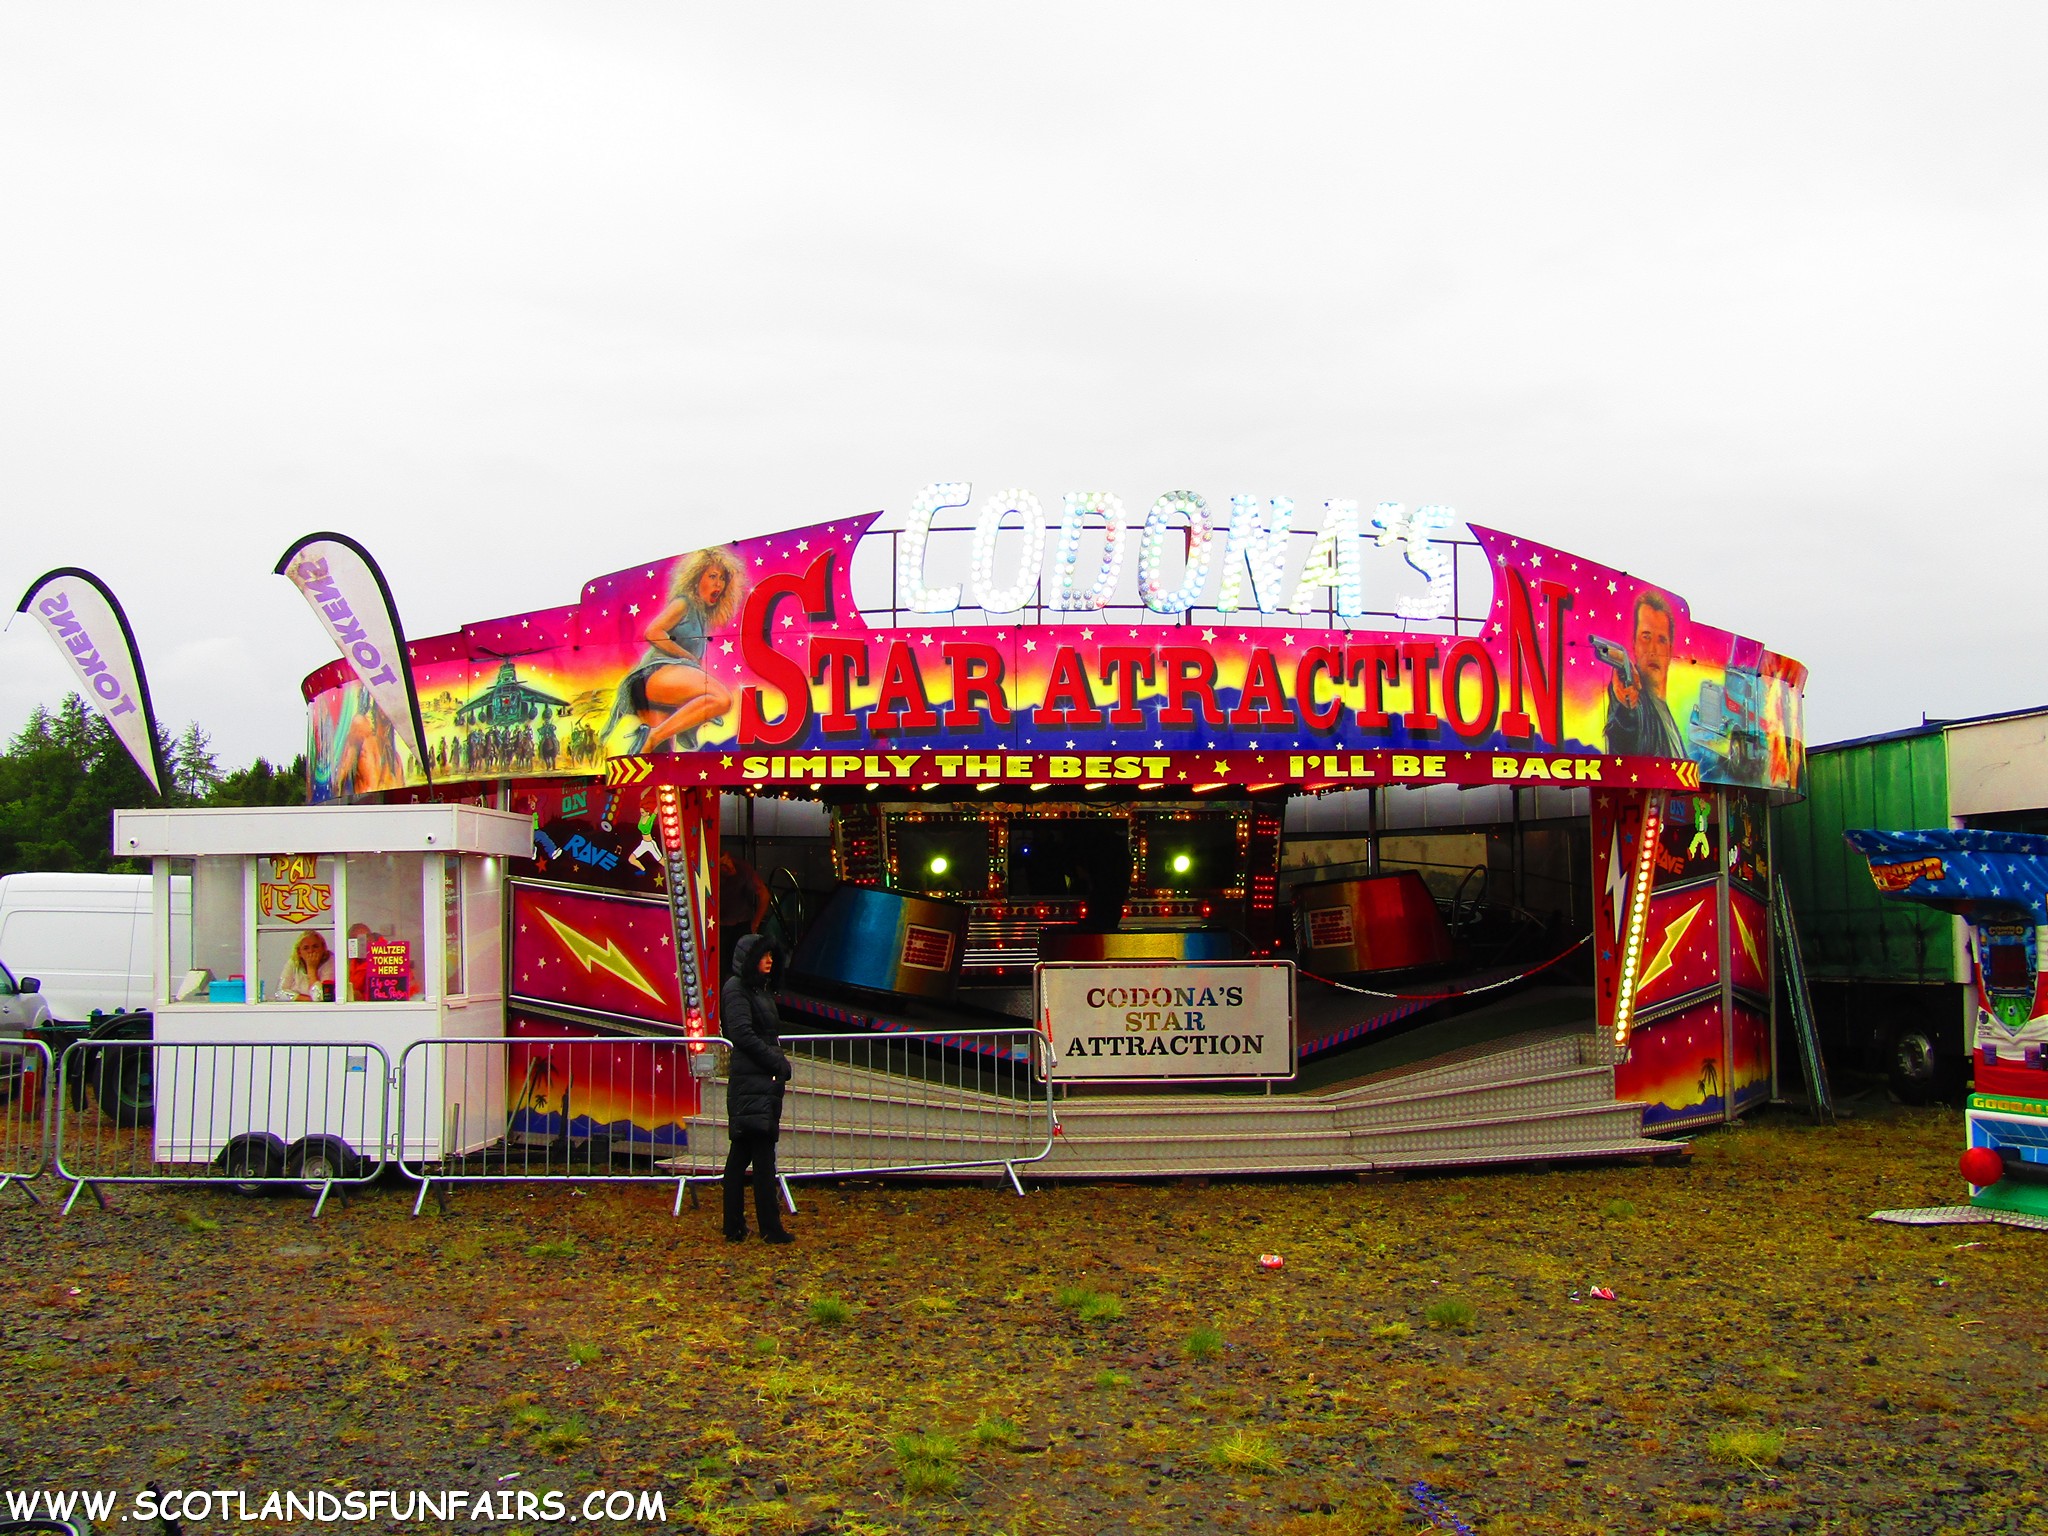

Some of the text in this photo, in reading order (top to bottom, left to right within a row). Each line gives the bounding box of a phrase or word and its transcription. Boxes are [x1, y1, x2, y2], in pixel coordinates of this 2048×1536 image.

[900, 482, 1456, 619] CODONA'S
[737, 549, 1572, 746] STAR ATRACTION
[742, 755, 1171, 779] SIMPLY THE BEST
[1289, 755, 1602, 780] I'LL BE BACK
[563, 834, 619, 871] RAVE
[271, 855, 317, 883] PAY
[260, 883, 332, 916] HERE
[371, 945, 406, 954] WALTZER
[373, 956, 404, 965] TOKENS
[378, 966, 399, 975] HERE
[1086, 986, 1243, 1008] CODONA'S
[1125, 1011, 1206, 1032] STAR
[1065, 1035, 1264, 1057] ATTRACTION
